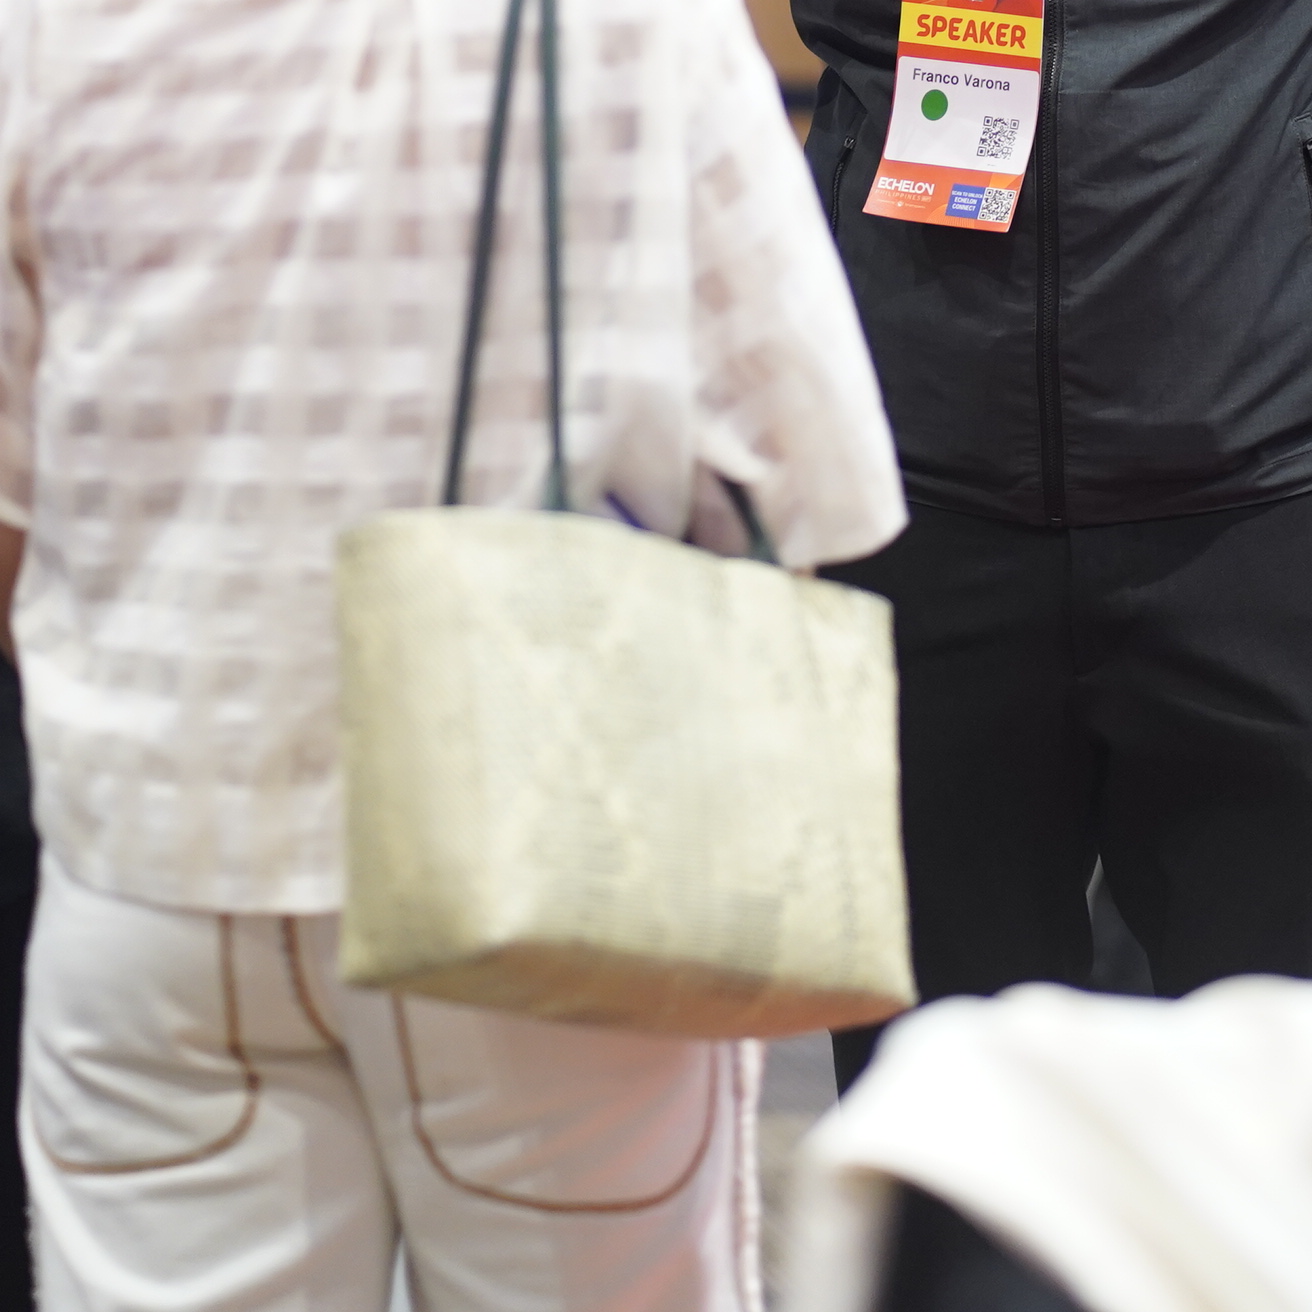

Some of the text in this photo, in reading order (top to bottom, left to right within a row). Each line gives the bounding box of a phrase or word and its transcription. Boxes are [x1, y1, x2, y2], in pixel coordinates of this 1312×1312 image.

[916, 13, 1027, 50] SPEAKER
[912, 67, 1011, 92] Franco Varona
[877, 176, 935, 196] ECHELON
